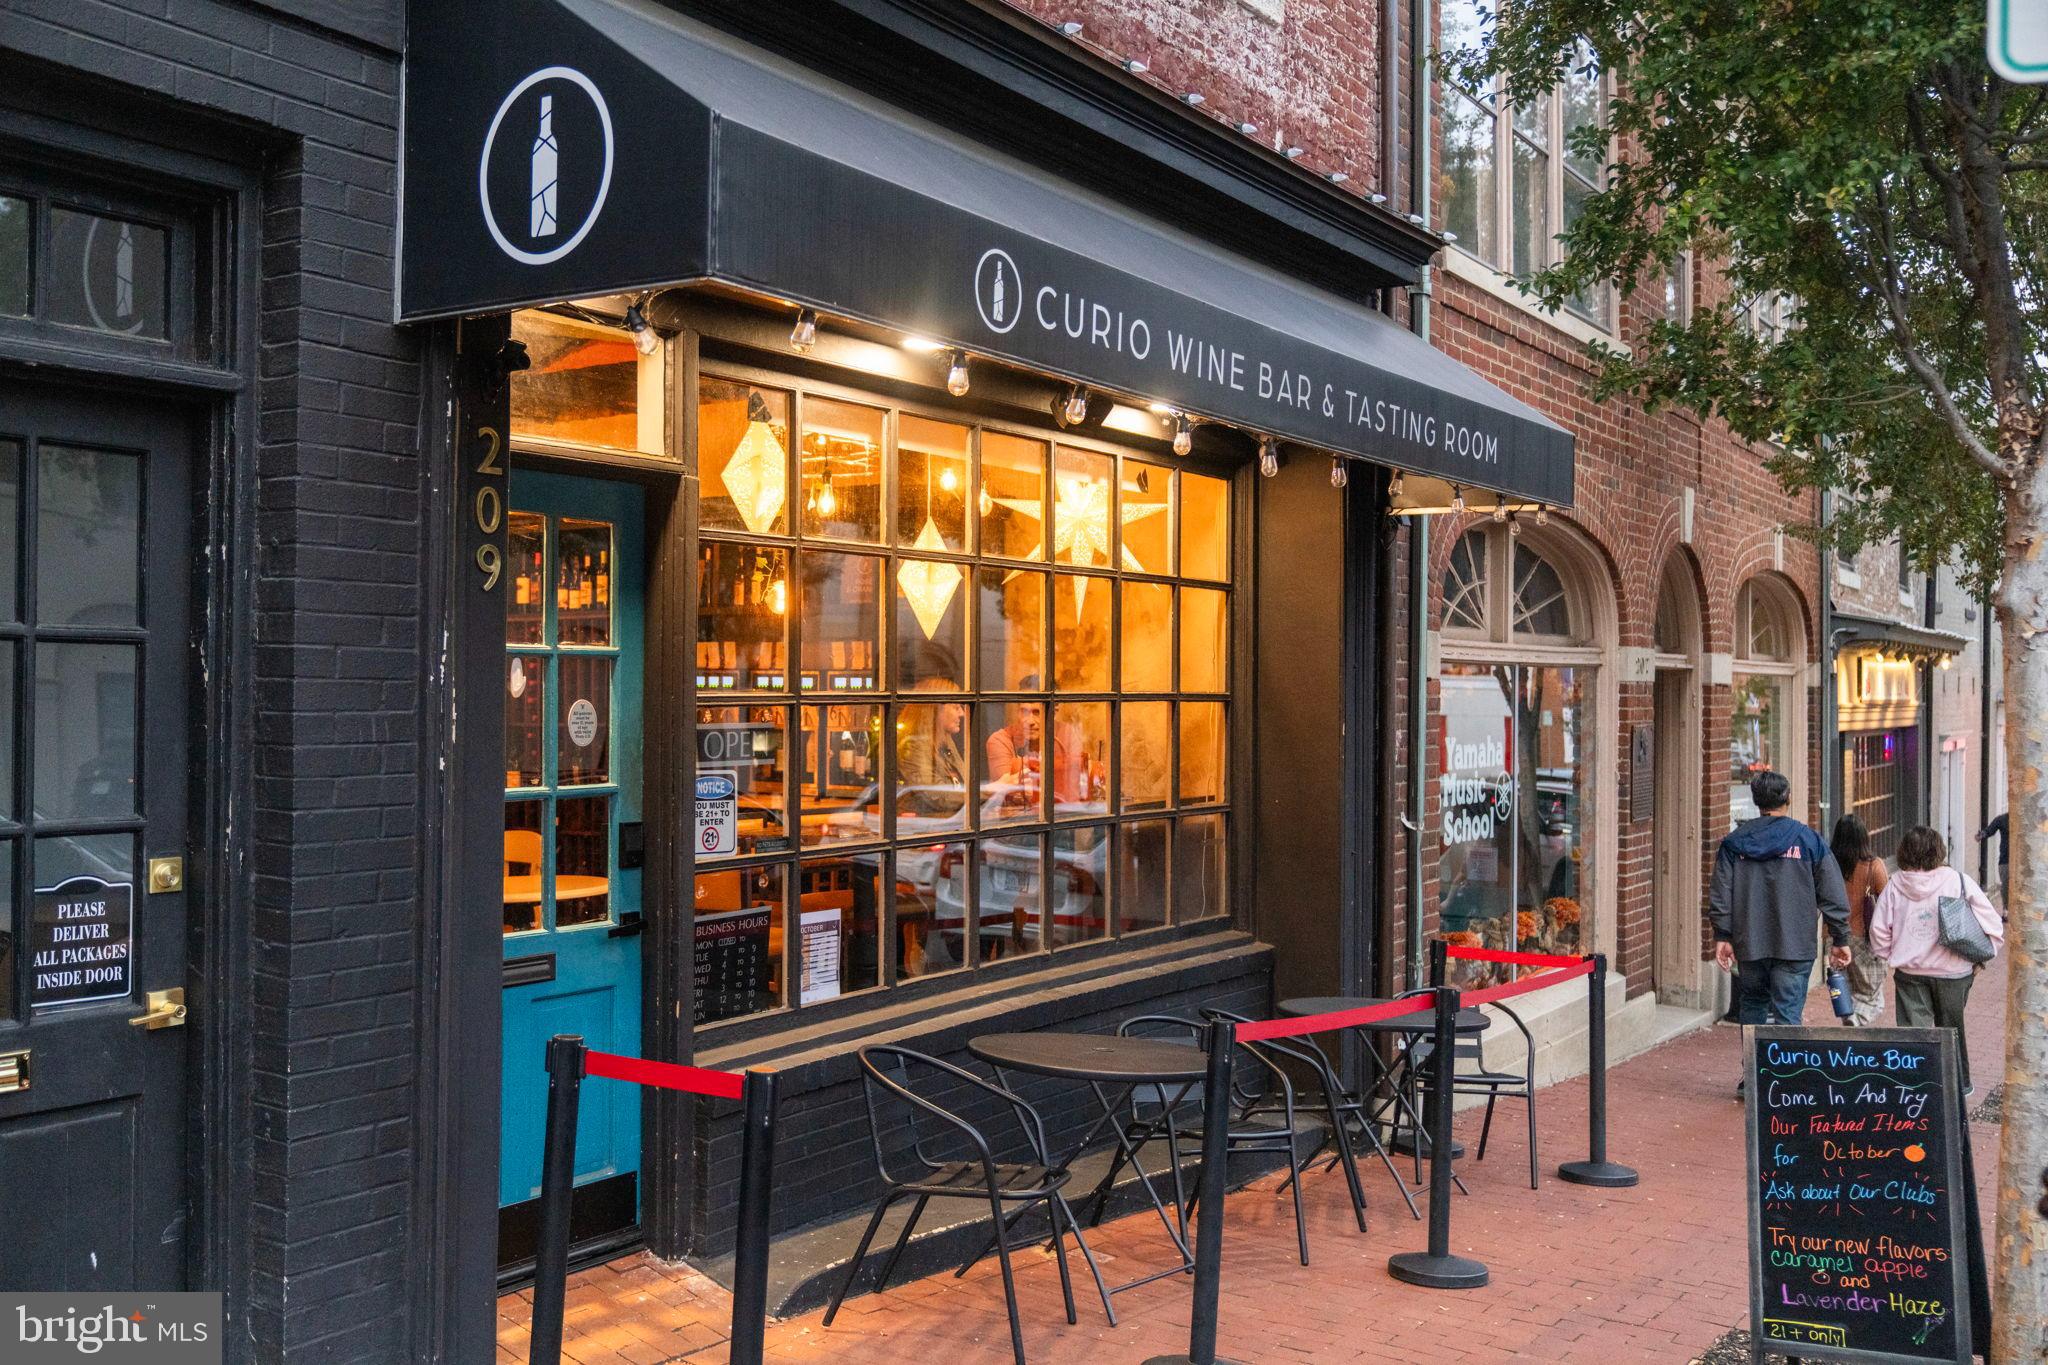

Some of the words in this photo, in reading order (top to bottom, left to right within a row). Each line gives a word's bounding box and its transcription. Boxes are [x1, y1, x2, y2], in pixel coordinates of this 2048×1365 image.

[1036, 286, 1151, 360] CURIO
[1167, 330, 1245, 391] WINE
[1259, 362, 1311, 410] BAR
[1322, 383, 1334, 418] &
[1345, 390, 1436, 447] TASTING
[1445, 422, 1497, 464] ROOM
[476, 426, 503, 592] 209
[703, 731, 769, 759] OPEN
[1445, 735, 1504, 771] Yamaha
[697, 781, 726, 794] NOTICE
[1440, 771, 1487, 808] Music
[700, 818, 724, 826] ENTER
[1443, 806, 1495, 847] School
[705, 832, 717, 843] 21+
[57, 901, 106, 920] PLEASE
[53, 923, 110, 943] DELIVER
[696, 921, 736, 936] BUSINESS
[738, 916, 768, 930] HOURS
[800, 924, 823, 934] OCTOBER
[33, 950, 59, 967] ALL
[61, 943, 127, 965] PACKAGES
[695, 940, 714, 951] MON
[695, 952, 709, 962] TUE
[723, 949, 728, 958] 4
[752, 944, 757, 953] 9
[694, 964, 712, 974] WED
[722, 960, 727, 970] 4
[751, 955, 756, 964] 9
[37, 970, 82, 990] INSIDE
[85, 966, 123, 984] DOOR
[694, 976, 709, 986] THU
[721, 972, 726, 981] 4
[750, 967, 755, 976] 9
[721, 984, 726, 993] 3
[749, 978, 756, 986] 10
[720, 995, 727, 1004] 12
[748, 989, 755, 998] 10
[748, 1001, 754, 1009] 6
[1767, 1042, 1821, 1065] Curio
[1828, 1046, 1879, 1067] Wine
[1883, 1049, 1925, 1070] Bar
[1768, 1080, 1817, 1108] Come
[1829, 1085, 1845, 1105] In
[1855, 1083, 1887, 1104] And
[1894, 1085, 1928, 1118] Try
[1771, 1115, 1799, 1135] Our
[1809, 1114, 1866, 1135] Featured
[1872, 1113, 1930, 1132] Items
[1773, 1143, 1799, 1167] for
[1823, 1140, 1901, 1161] October
[1765, 1180, 1795, 1200] Ask
[1801, 1184, 1840, 1199] about
[1885, 1181, 1935, 1204] Clubs
[1768, 1227, 1797, 1255] Try
[1801, 1237, 1832, 1251] our
[1835, 1238, 1870, 1255] new
[1840, 1274, 1870, 1288] and
[1864, 1258, 1927, 1283] apple
[1781, 1283, 1887, 1312] Lavender
[1890, 1292, 1946, 1317] Haze
[1809, 1329, 1841, 1348] only
